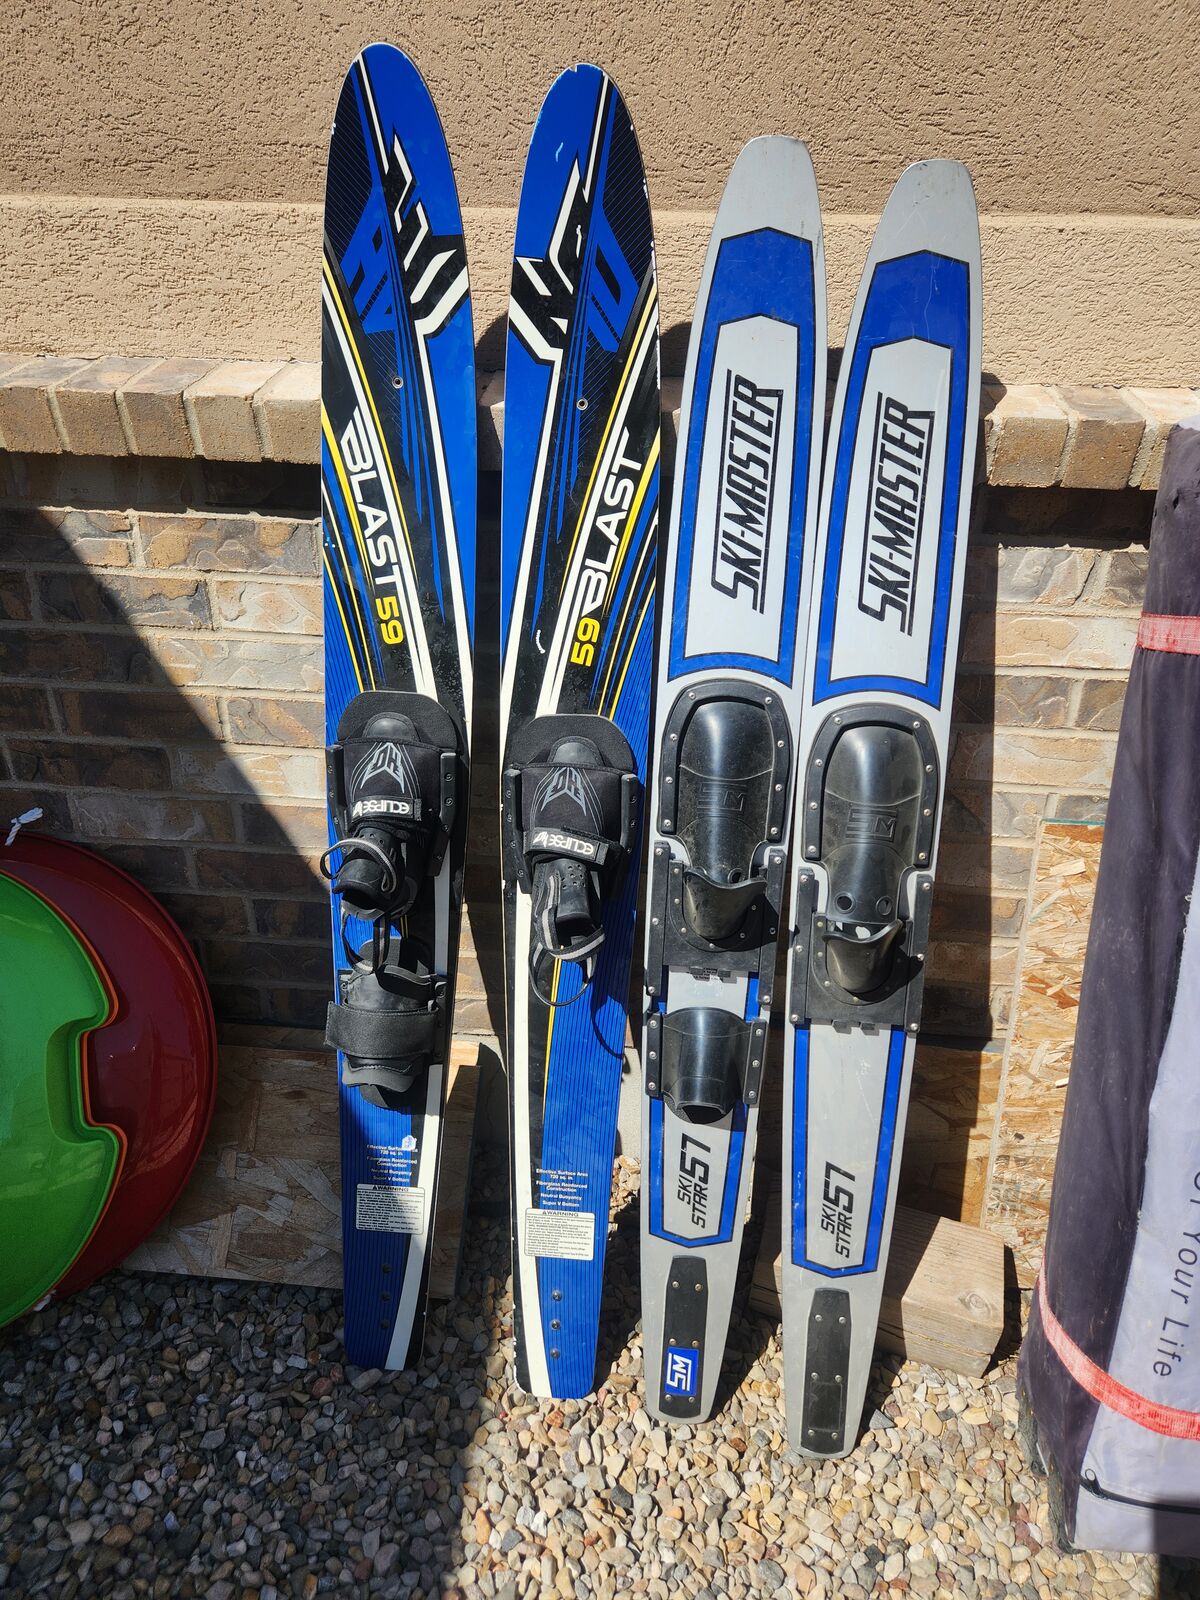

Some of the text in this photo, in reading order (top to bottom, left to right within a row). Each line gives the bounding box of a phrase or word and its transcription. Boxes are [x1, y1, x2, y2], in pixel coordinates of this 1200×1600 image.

[712, 368, 784, 614] SKI-MASTER
[858, 391, 935, 637] SKI-MASTER
[340, 405, 404, 645] BLAST 59
[570, 426, 642, 667] BLAST 59
[363, 800, 410, 815] ECLIPSE
[548, 834, 593, 855] ECLIPSE
[677, 1174, 692, 1205] SKI
[691, 1182, 708, 1229] STAR
[820, 1203, 836, 1234] SKI
[835, 1212, 852, 1259] STAR
[1152, 1316, 1190, 1377] Life
[666, 1352, 691, 1391] SM
